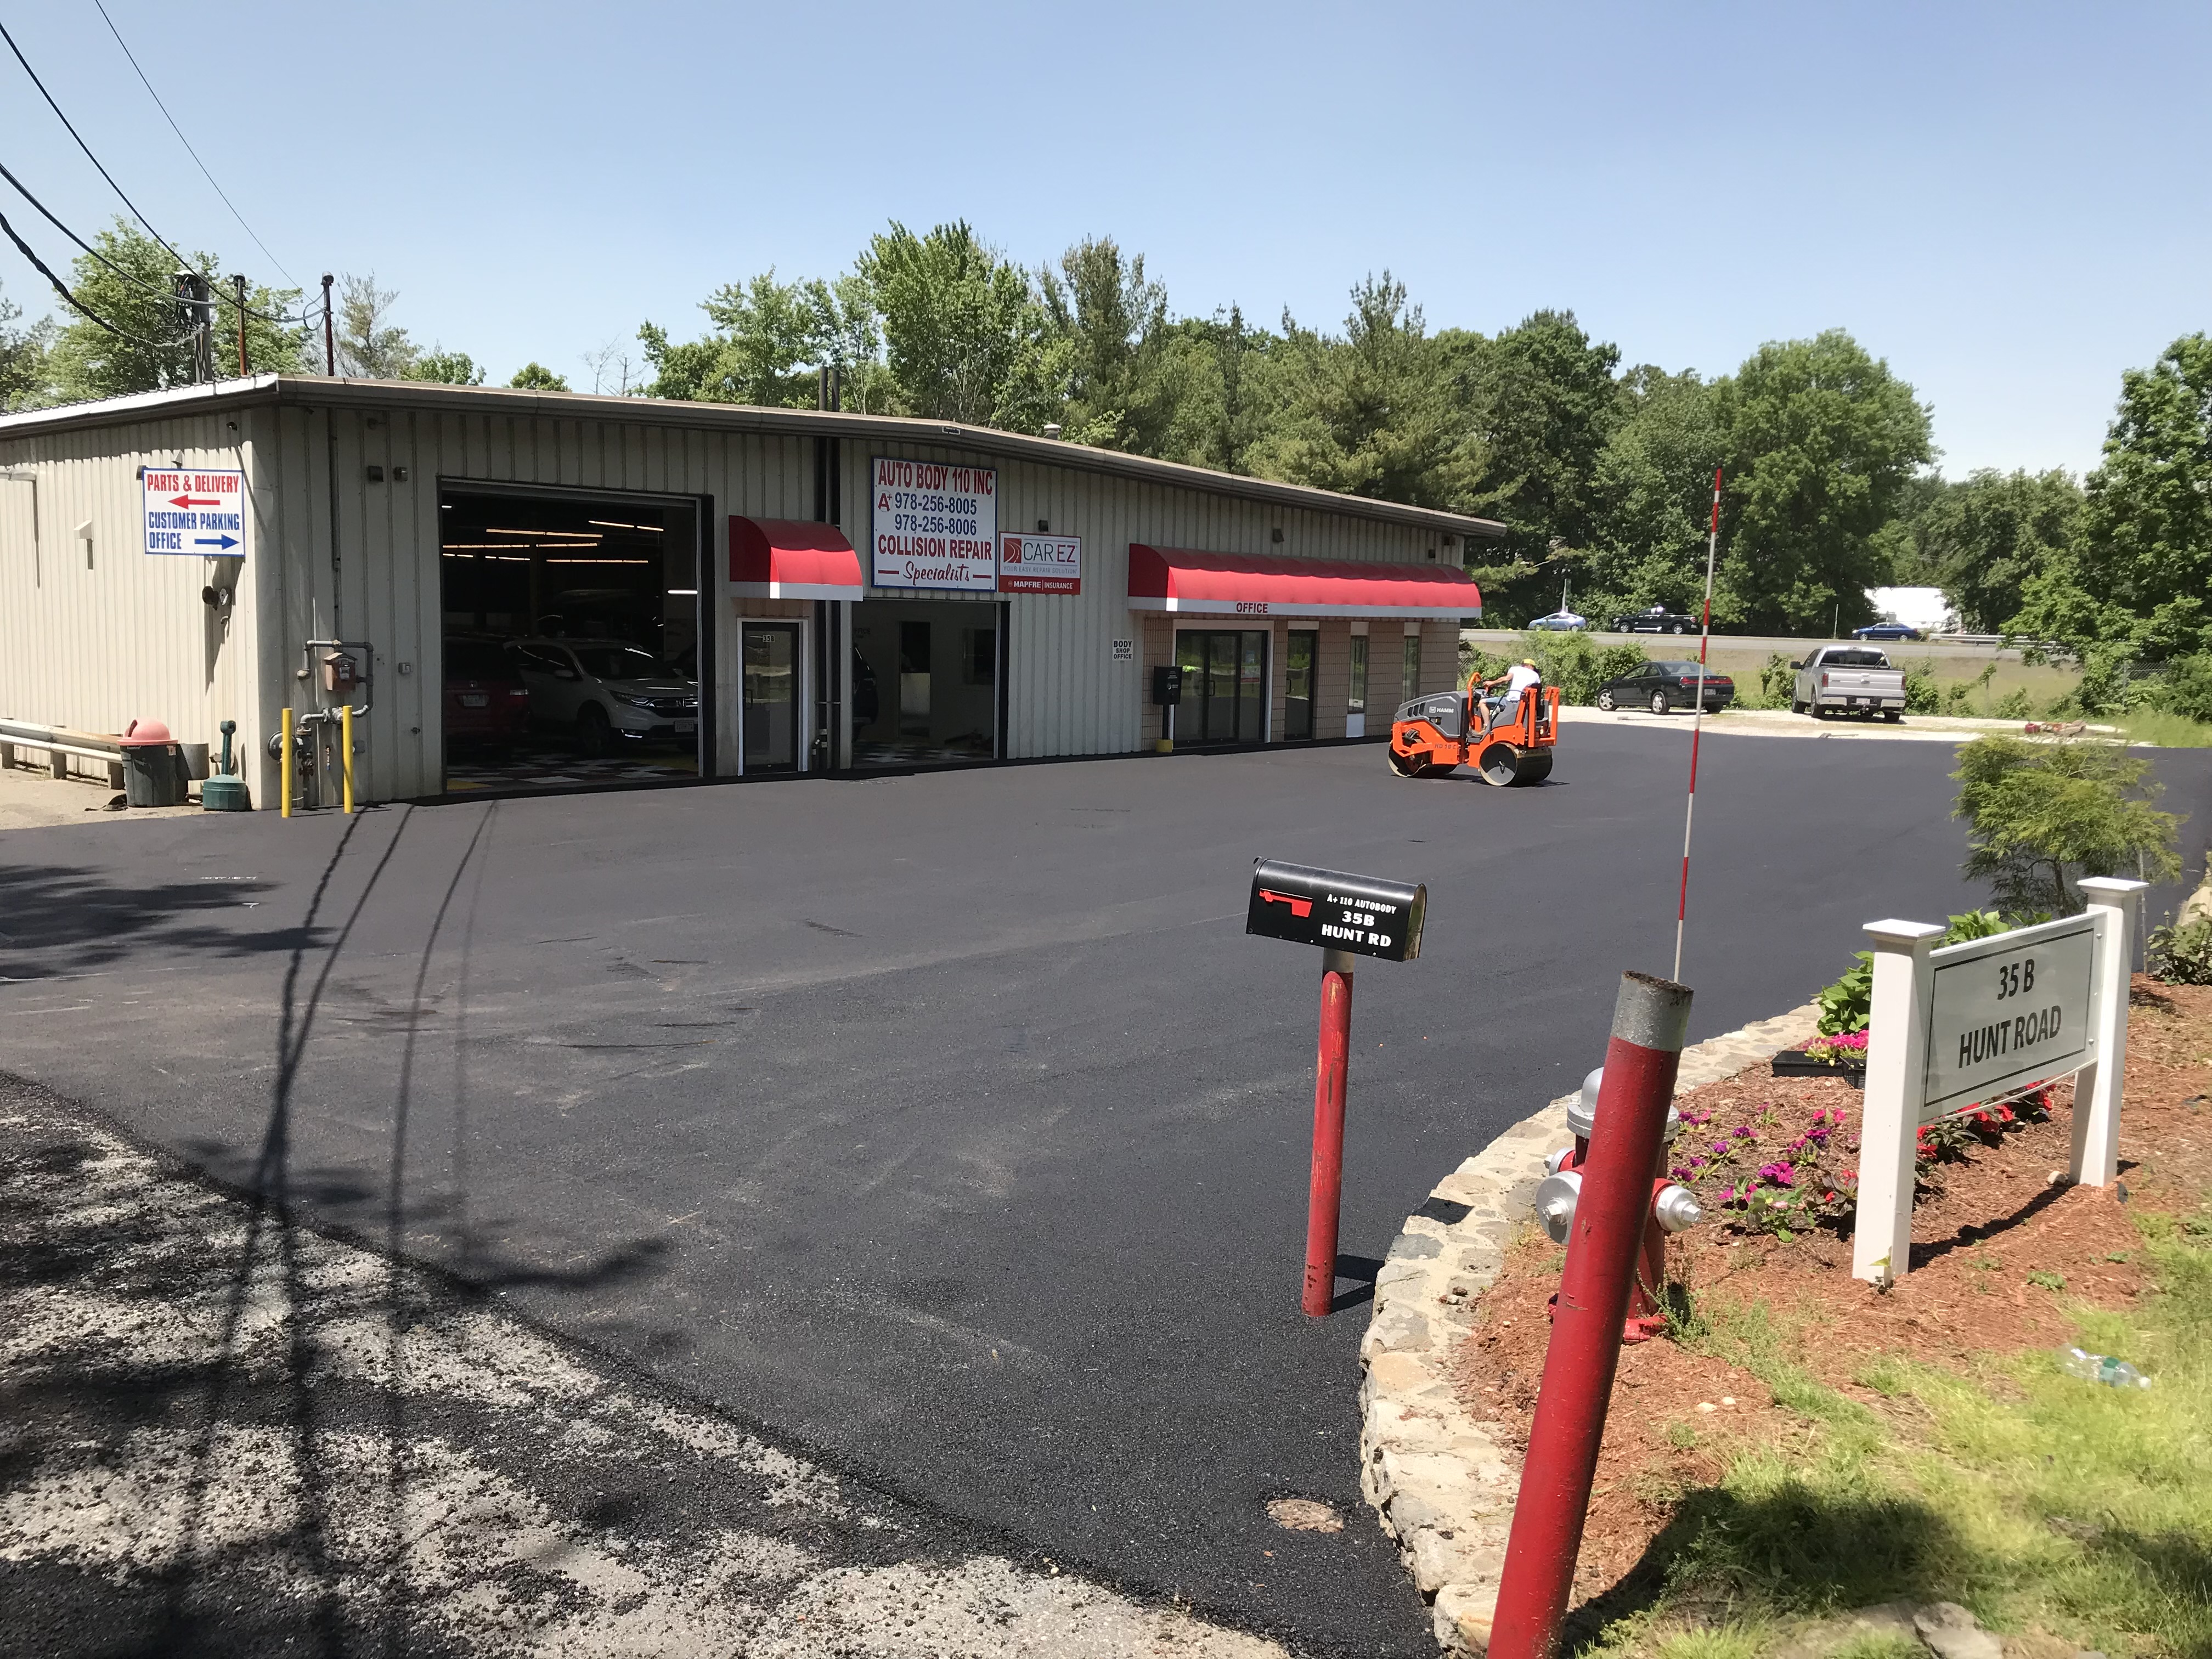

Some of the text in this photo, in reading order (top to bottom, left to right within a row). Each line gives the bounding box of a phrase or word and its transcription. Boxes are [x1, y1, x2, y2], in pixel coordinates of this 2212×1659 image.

[147, 474, 239, 493] PARTS & DELIVERY
[878, 460, 992, 495] AUTO BODY 110 INC
[895, 492, 977, 515] 978-256-8005
[148, 511, 240, 530] CUSTOMER PARKING
[895, 514, 977, 535] 978-256-8006
[149, 532, 182, 549] OFFICE
[878, 534, 992, 560] COLLISION REPAIR
[903, 561, 969, 586] Specialists
[1236, 602, 1268, 613] OFFICE
[1327, 894, 1397, 914] A+ 110 AUTOBODY
[1342, 911, 1375, 926] 35B
[1321, 924, 1391, 947] HUNT RD
[1997, 958, 2035, 1000] 35 B
[1959, 1005, 2062, 1069] HUNT ROAD
